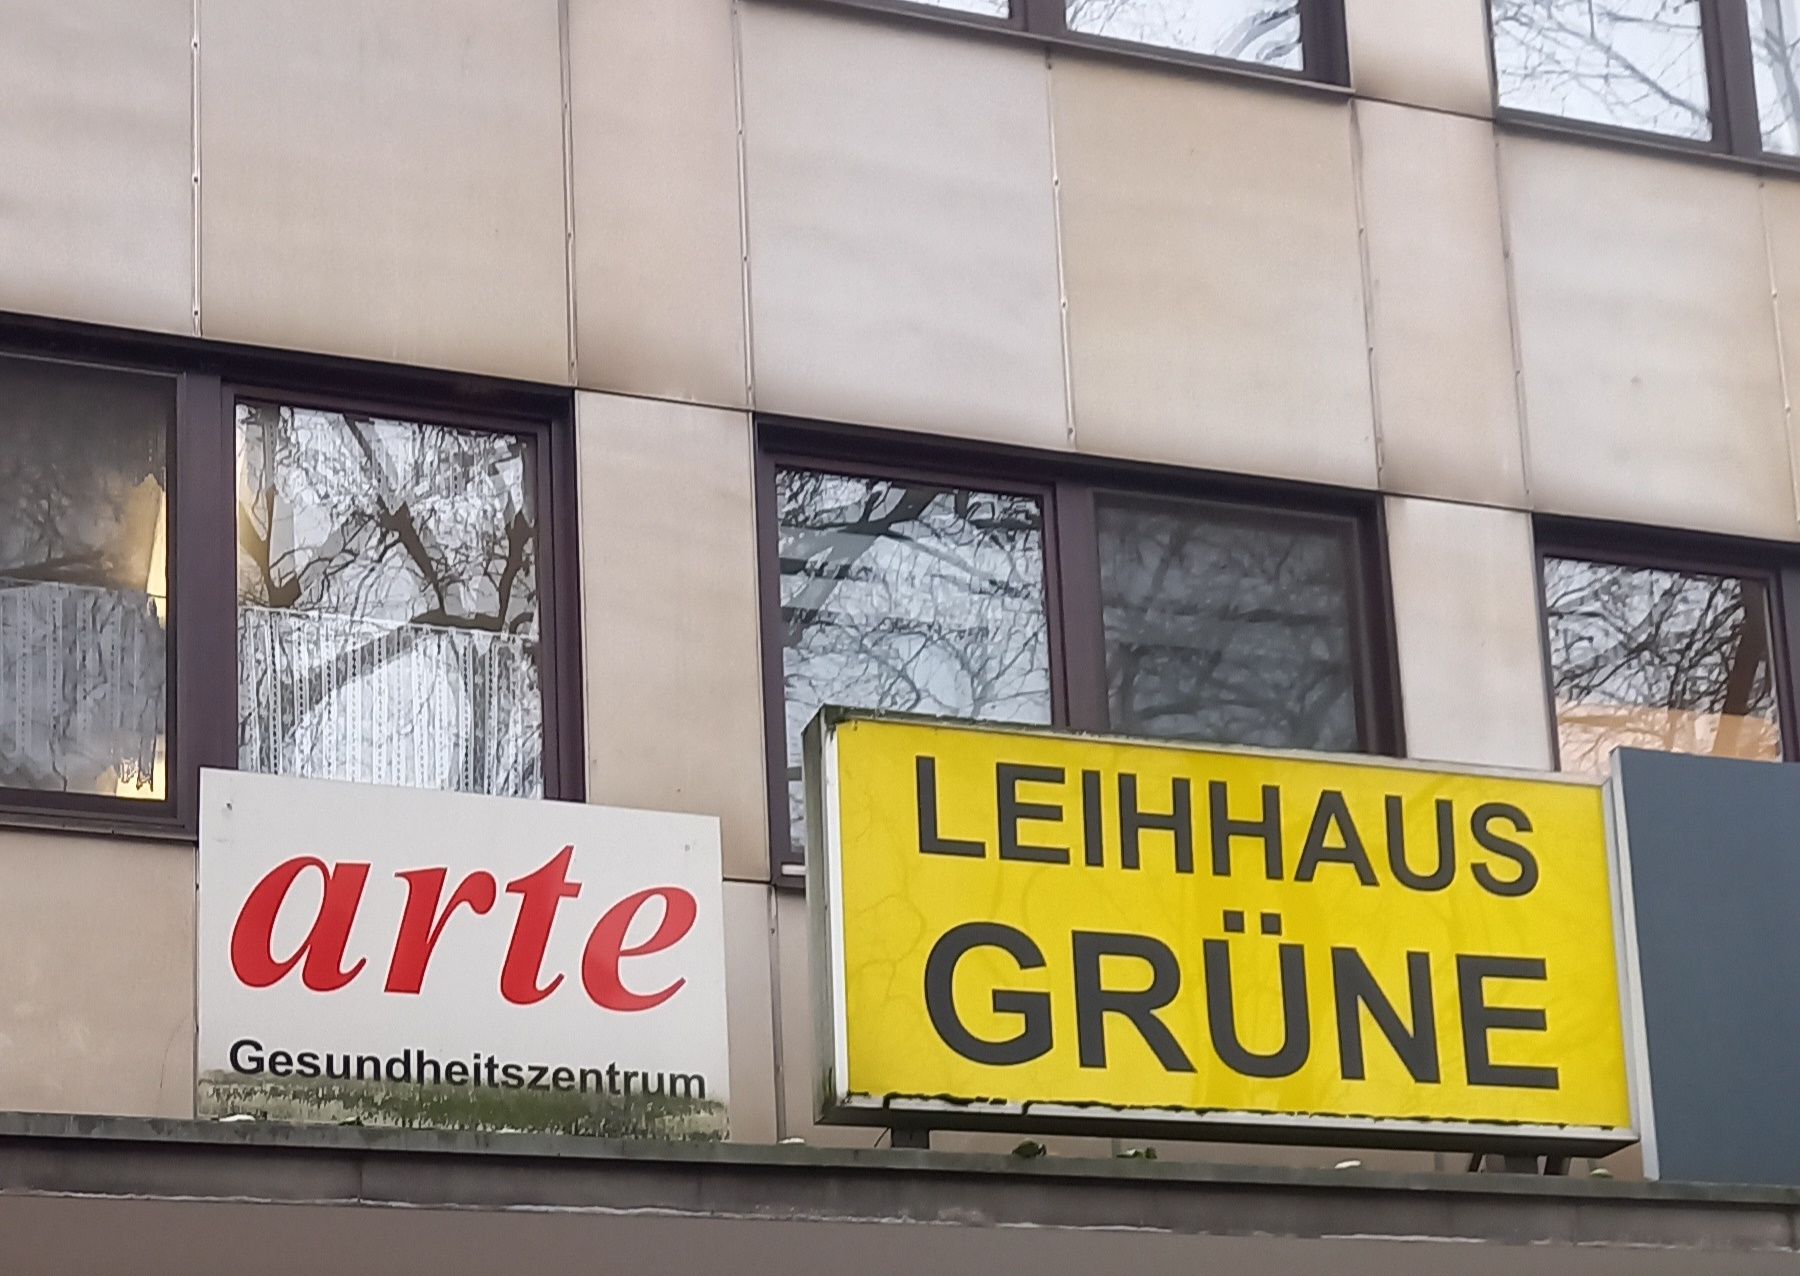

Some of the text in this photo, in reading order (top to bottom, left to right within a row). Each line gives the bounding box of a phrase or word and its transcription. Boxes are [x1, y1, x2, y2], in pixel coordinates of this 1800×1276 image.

[915, 755, 1539, 897] LEIHHAUS
[230, 845, 698, 1013] arte
[923, 909, 1560, 1090] GRÜNE
[229, 1039, 706, 1098] Gesundheitszentrum
